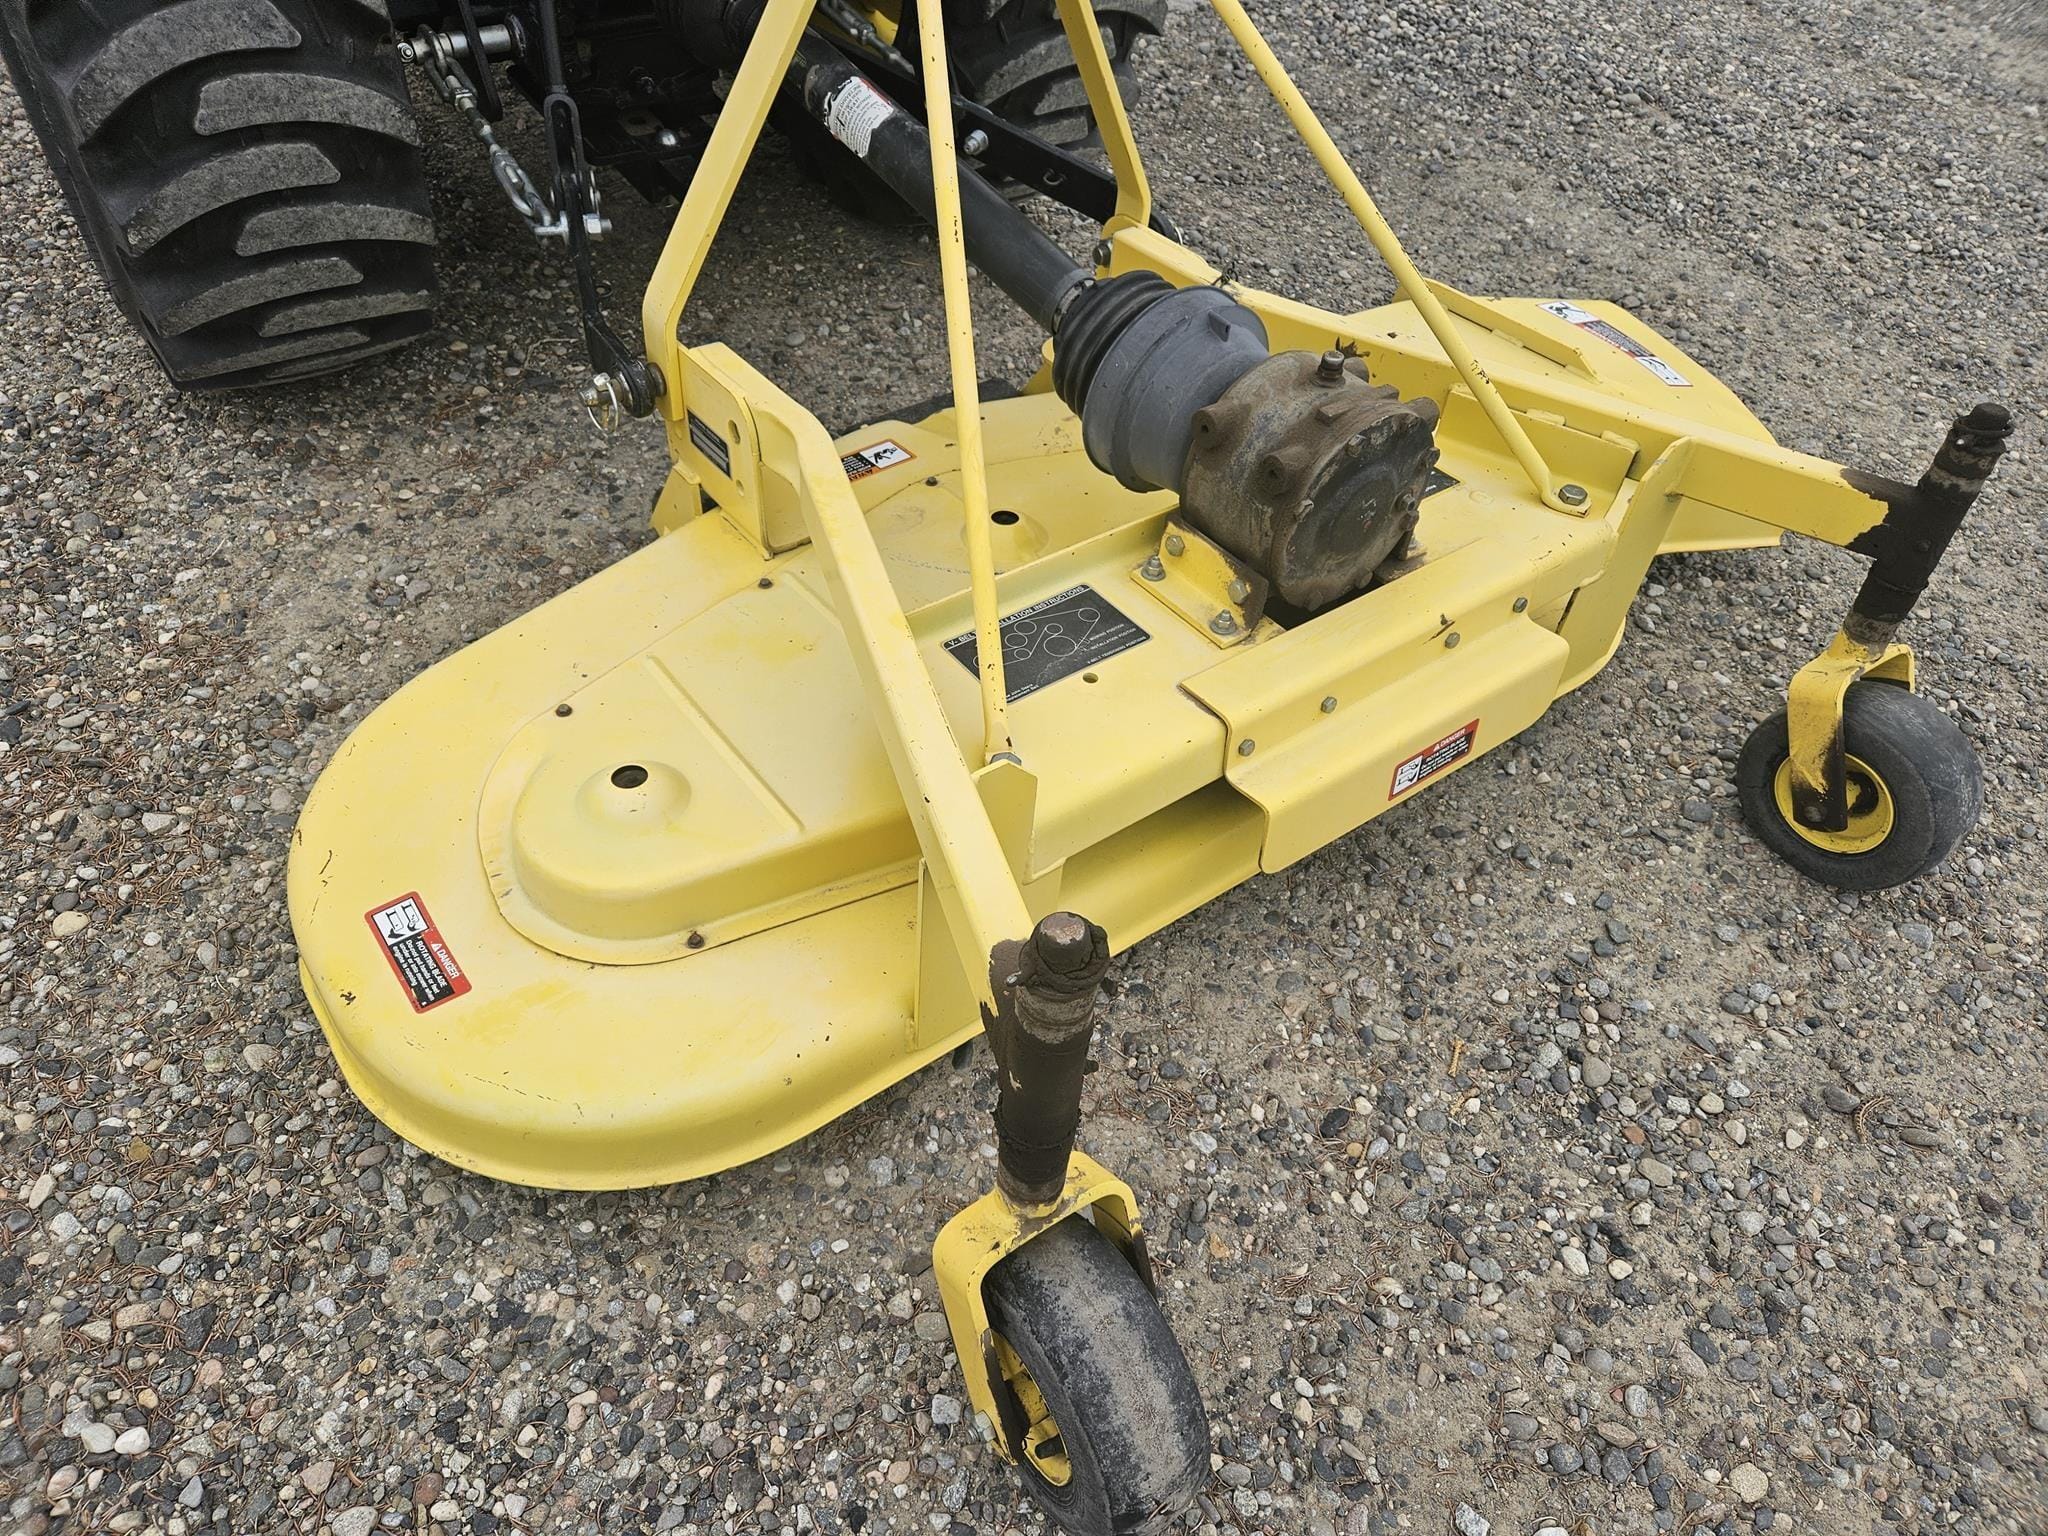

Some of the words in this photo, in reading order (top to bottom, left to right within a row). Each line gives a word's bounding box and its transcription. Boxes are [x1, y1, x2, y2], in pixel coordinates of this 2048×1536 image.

[999, 608, 1033, 626] LLATION
[1033, 586, 1085, 611] INSTRUCTIONS
[405, 967, 418, 987] running
[416, 940, 437, 969] ROTATING
[431, 967, 448, 988] BLADE
[437, 949, 459, 979] DANGER
